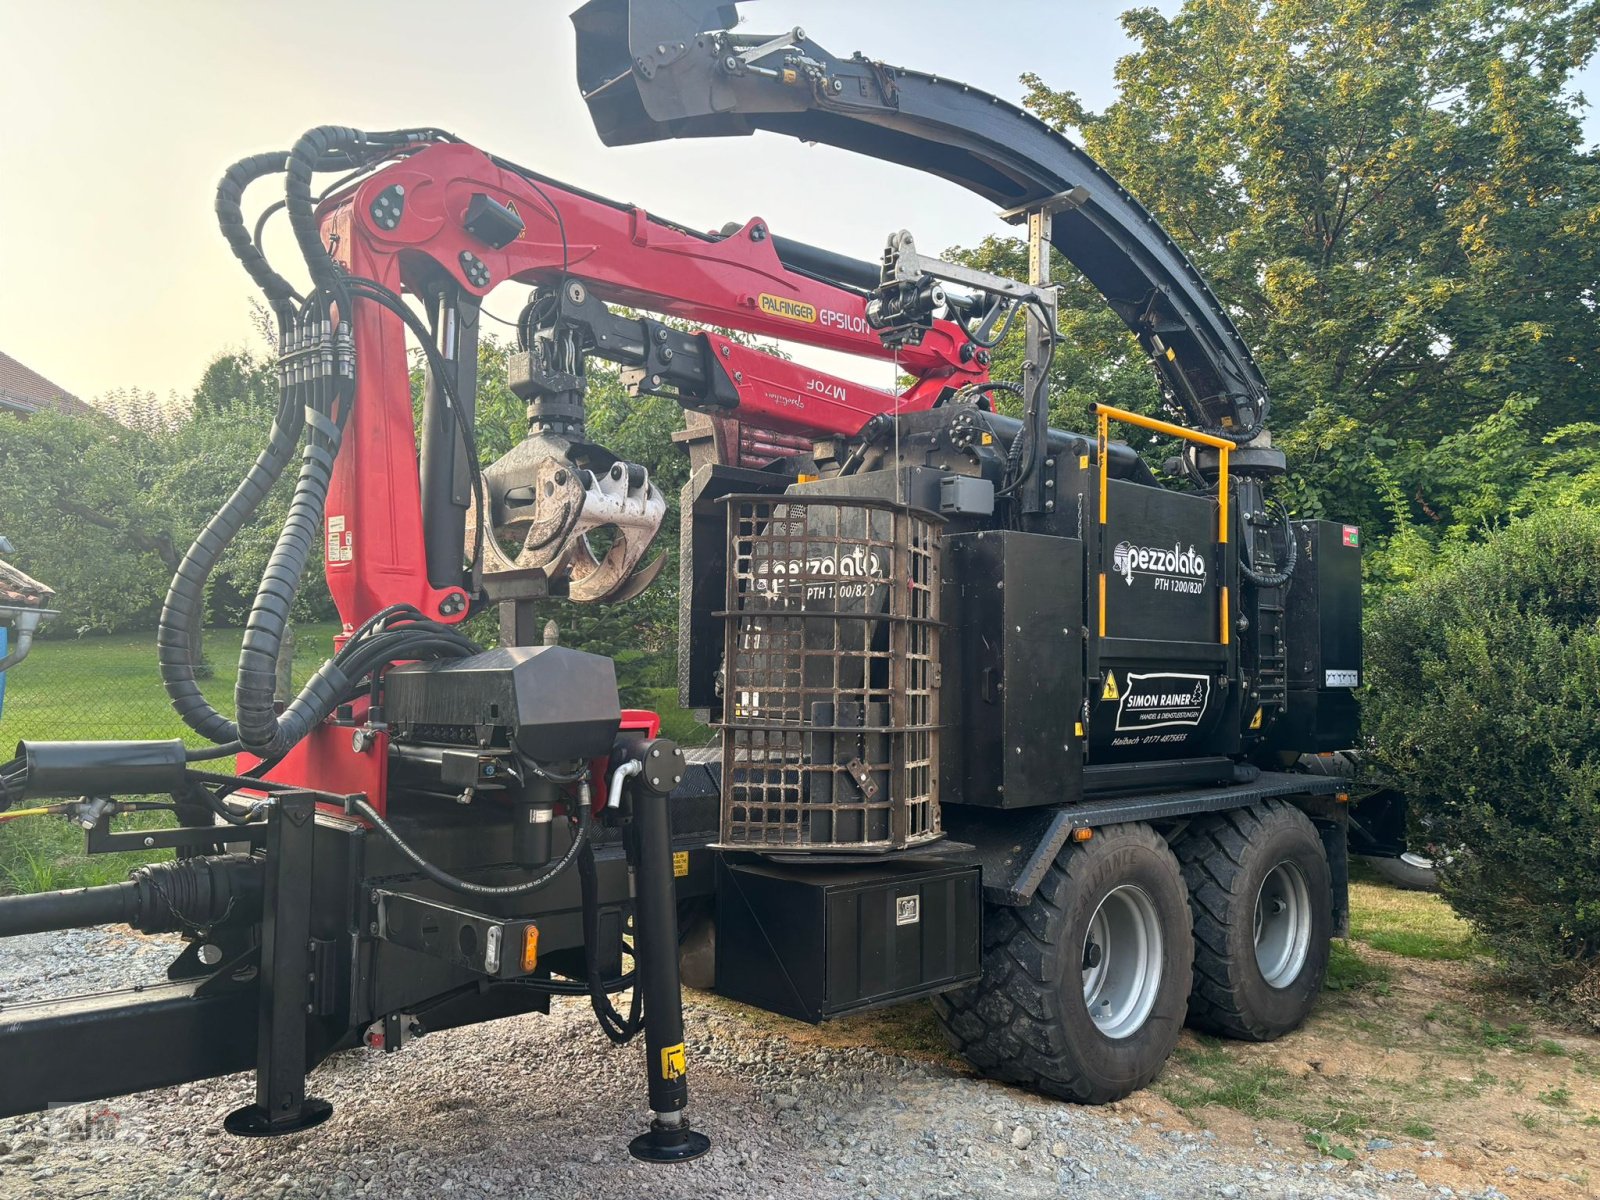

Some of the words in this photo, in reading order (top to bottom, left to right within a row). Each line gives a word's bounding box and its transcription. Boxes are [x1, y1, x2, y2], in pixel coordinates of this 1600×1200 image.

[762, 296, 814, 320] PALFINGER
[819, 309, 870, 334] EPSILON
[807, 379, 847, 401] M70F
[1125, 541, 1206, 585] pezzolato
[1154, 577, 1170, 591] PTH
[1171, 580, 1203, 594] 1200/820
[806, 587, 826, 600] PTH
[1127, 694, 1159, 707] SIMON
[1160, 693, 1191, 706] RAINER
[1161, 711, 1199, 720] DIENSTLEISTUNGEN
[1111, 736, 1140, 746] Haibach
[1143, 735, 1160, 744] 0171
